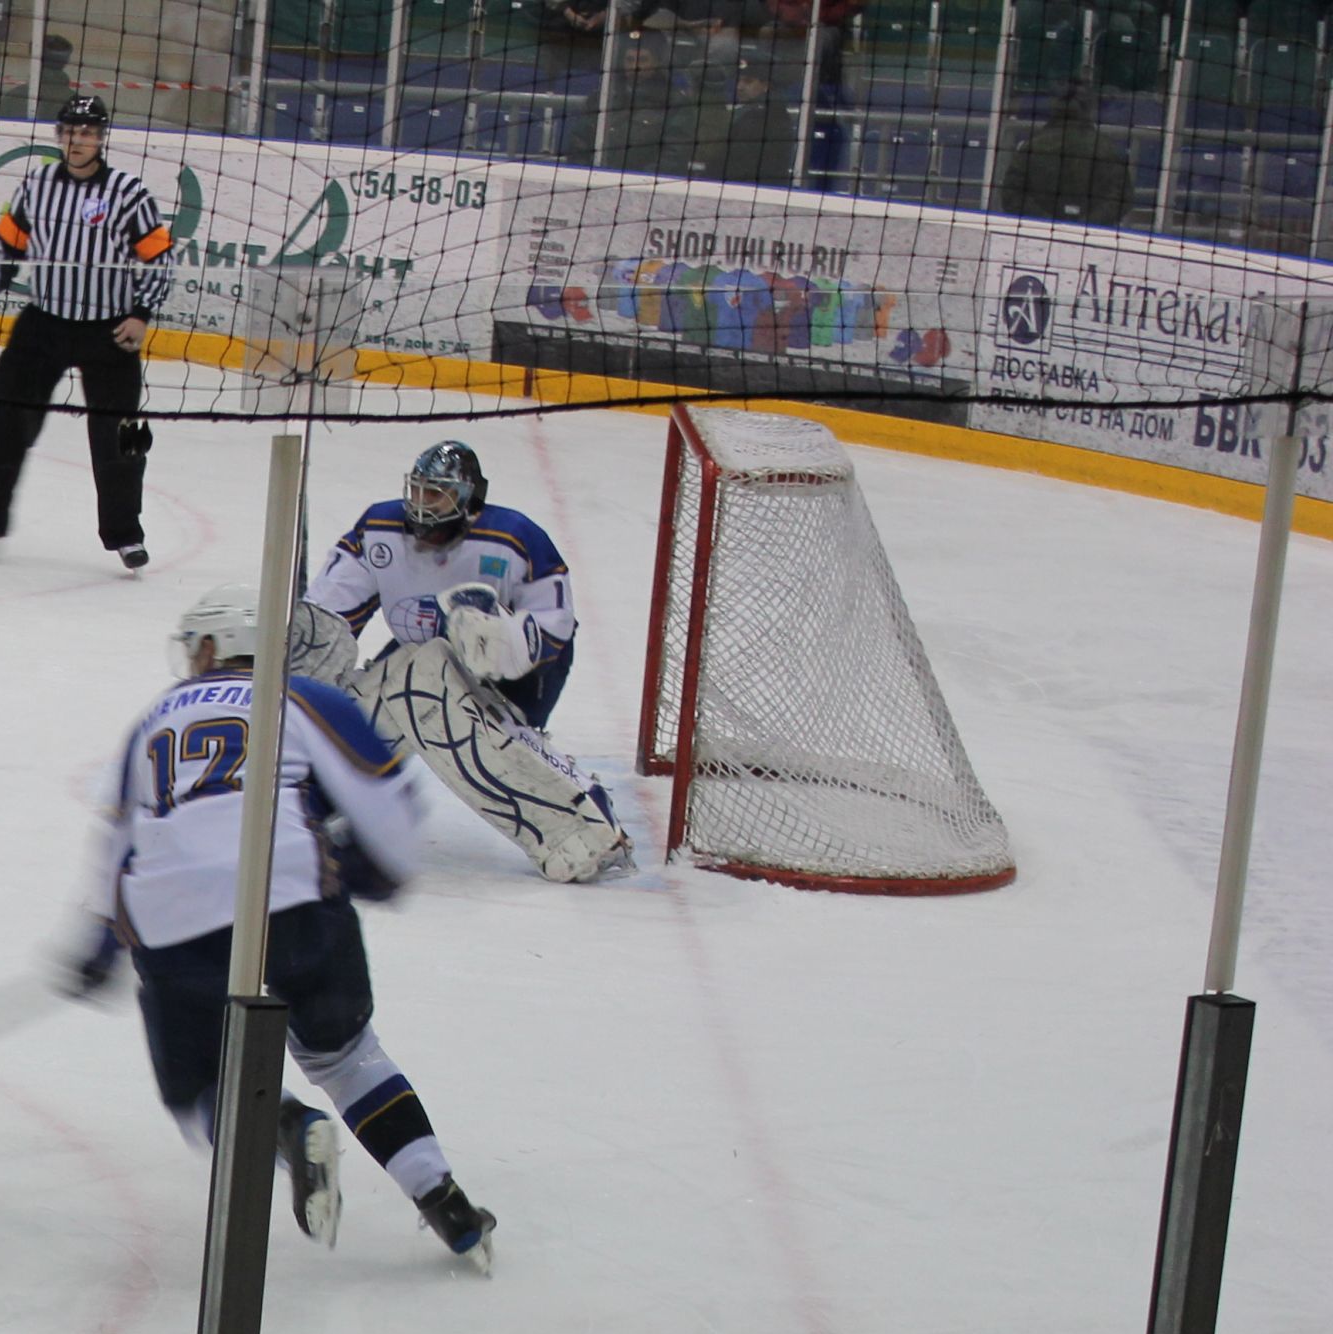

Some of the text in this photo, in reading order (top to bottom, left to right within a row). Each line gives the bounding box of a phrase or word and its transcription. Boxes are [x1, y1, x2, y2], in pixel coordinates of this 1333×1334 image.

[1070, 263, 1231, 346] Аптека
[990, 355, 1100, 393] ДОСТАВКА
[1129, 412, 1174, 441] ДОМ
[147, 716, 250, 815] 12
